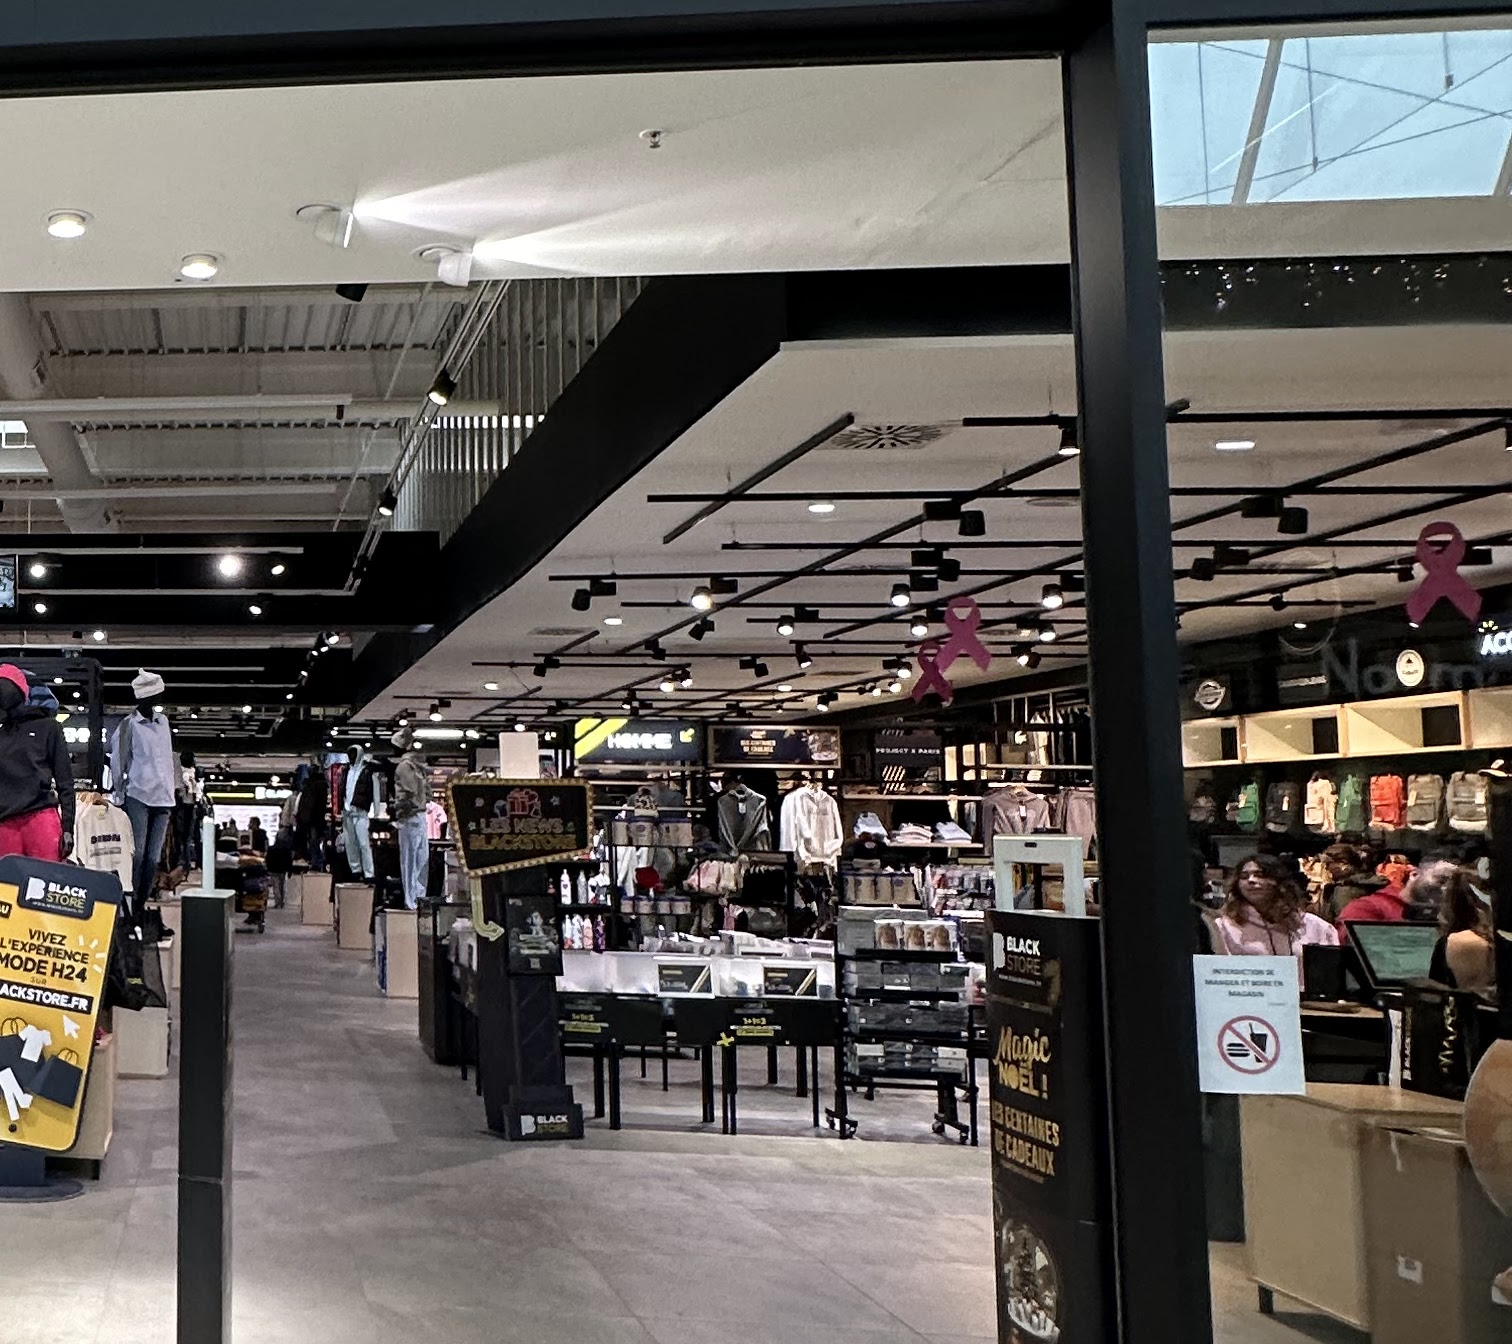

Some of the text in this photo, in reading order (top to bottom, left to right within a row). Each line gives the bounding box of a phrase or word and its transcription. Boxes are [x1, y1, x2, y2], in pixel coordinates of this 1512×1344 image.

[607, 732, 673, 749] HOMME
[479, 817, 563, 834] LES NEWS
[469, 833, 577, 850] BLACKSTORE
[47, 881, 87, 899] BLACK
[46, 892, 86, 909] STORE
[28, 928, 67, 946] VIVEZ
[1006, 935, 1041, 956] BLACK
[50, 963, 88, 983] H24
[1006, 953, 1041, 975] STORE
[992, 1025, 1051, 1067] Magic
[536, 1114, 568, 1124] BLACK
[1004, 1106, 1060, 1147] CENTAINES
[1005, 1133, 1055, 1176] CADEAUX
